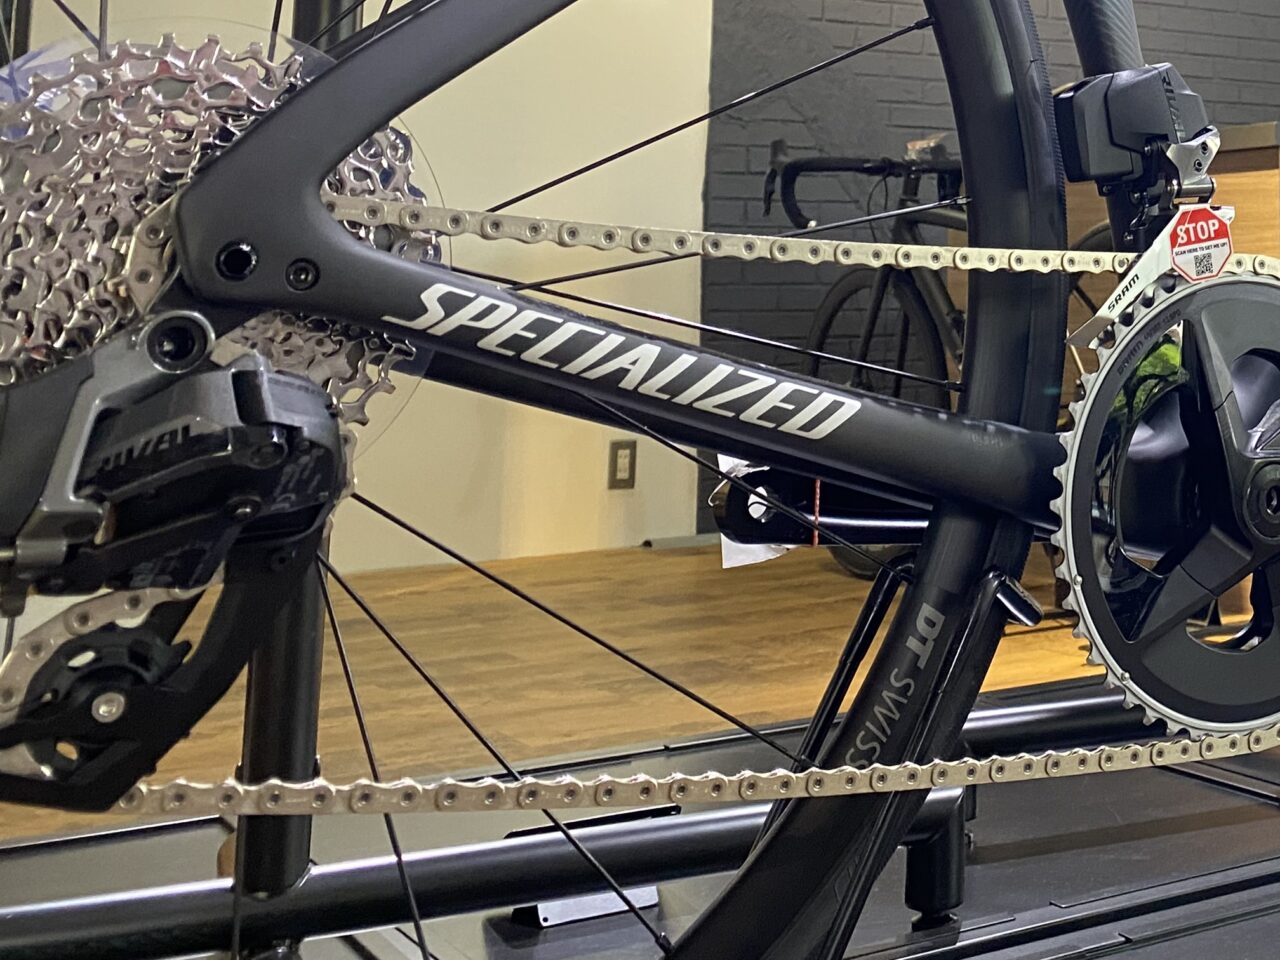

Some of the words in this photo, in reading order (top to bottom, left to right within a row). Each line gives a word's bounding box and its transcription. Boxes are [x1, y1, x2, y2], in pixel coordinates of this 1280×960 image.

[1174, 249, 1187, 257] SCAN
[1176, 219, 1220, 244] STOP
[1107, 273, 1140, 313] SRAM
[381, 282, 862, 440] SPECIALIZED
[905, 602, 946, 670] DT
[845, 668, 915, 770] SWISS
